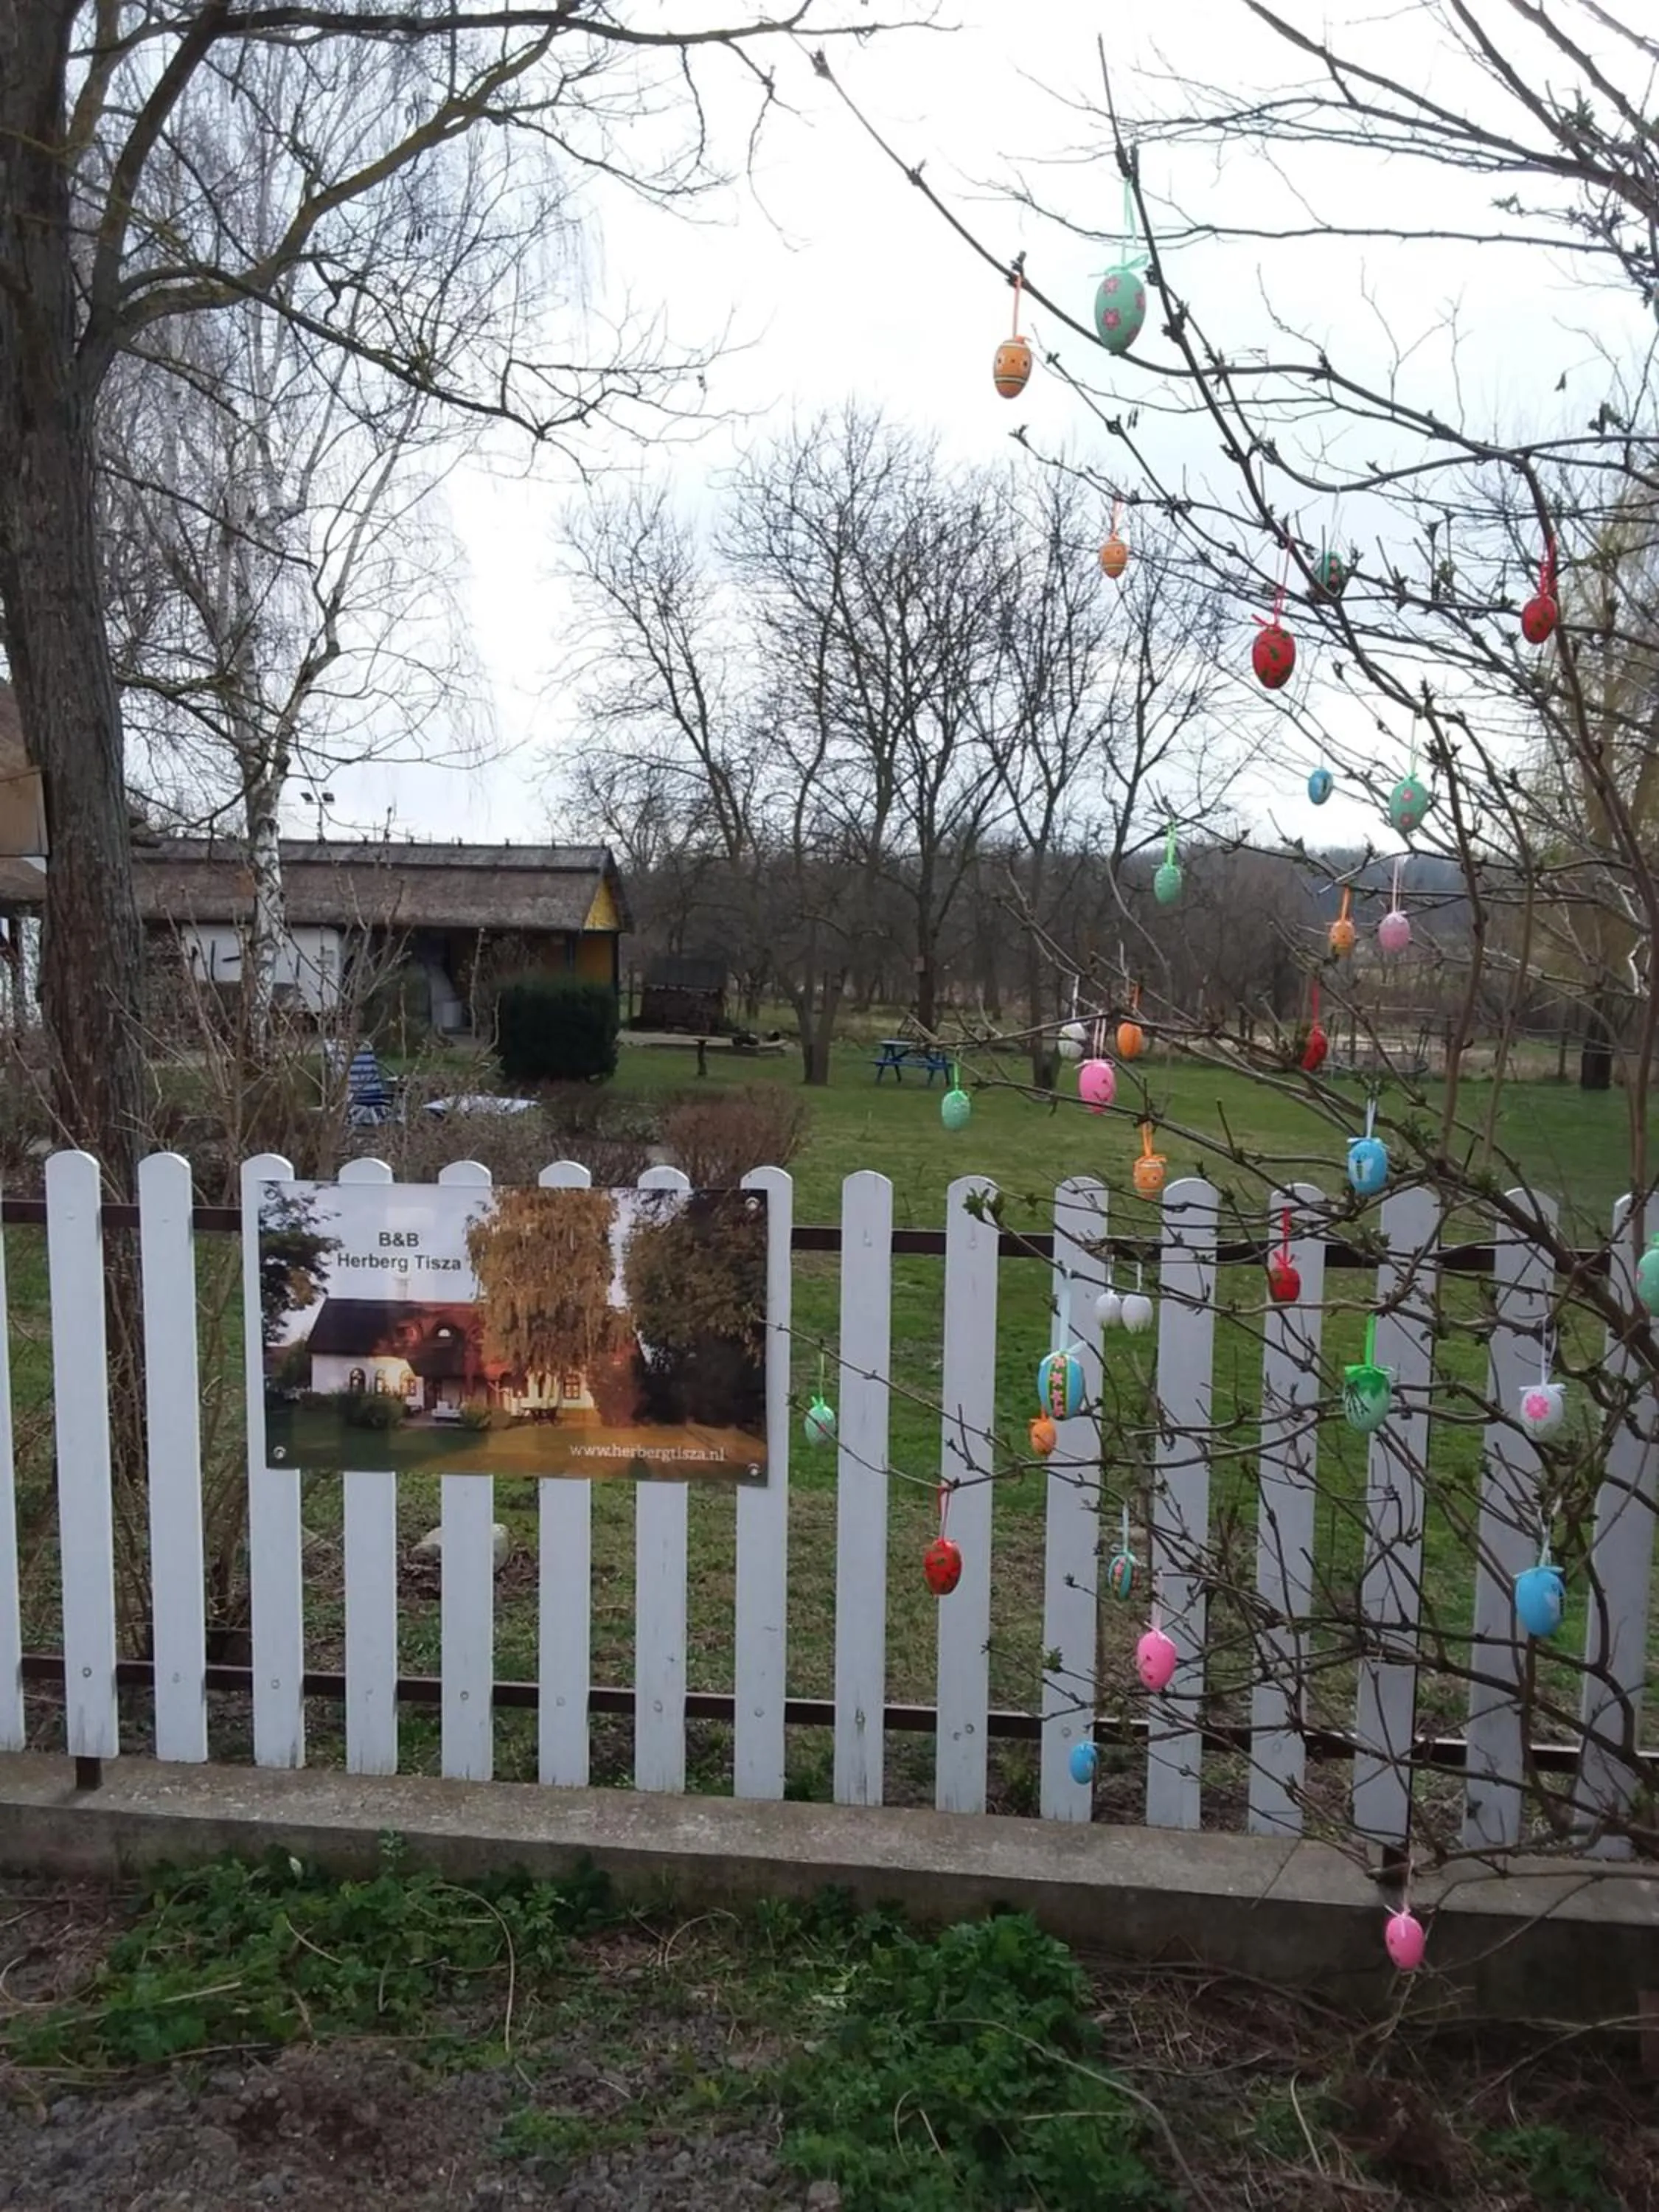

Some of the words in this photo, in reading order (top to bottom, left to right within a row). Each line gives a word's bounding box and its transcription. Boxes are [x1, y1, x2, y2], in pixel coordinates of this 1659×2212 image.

[378, 1232, 420, 1247] B&B
[337, 1253, 408, 1273] Herberg
[414, 1255, 462, 1270] Tisza
[570, 1443, 725, 1462] www.herbergtisza.nl
